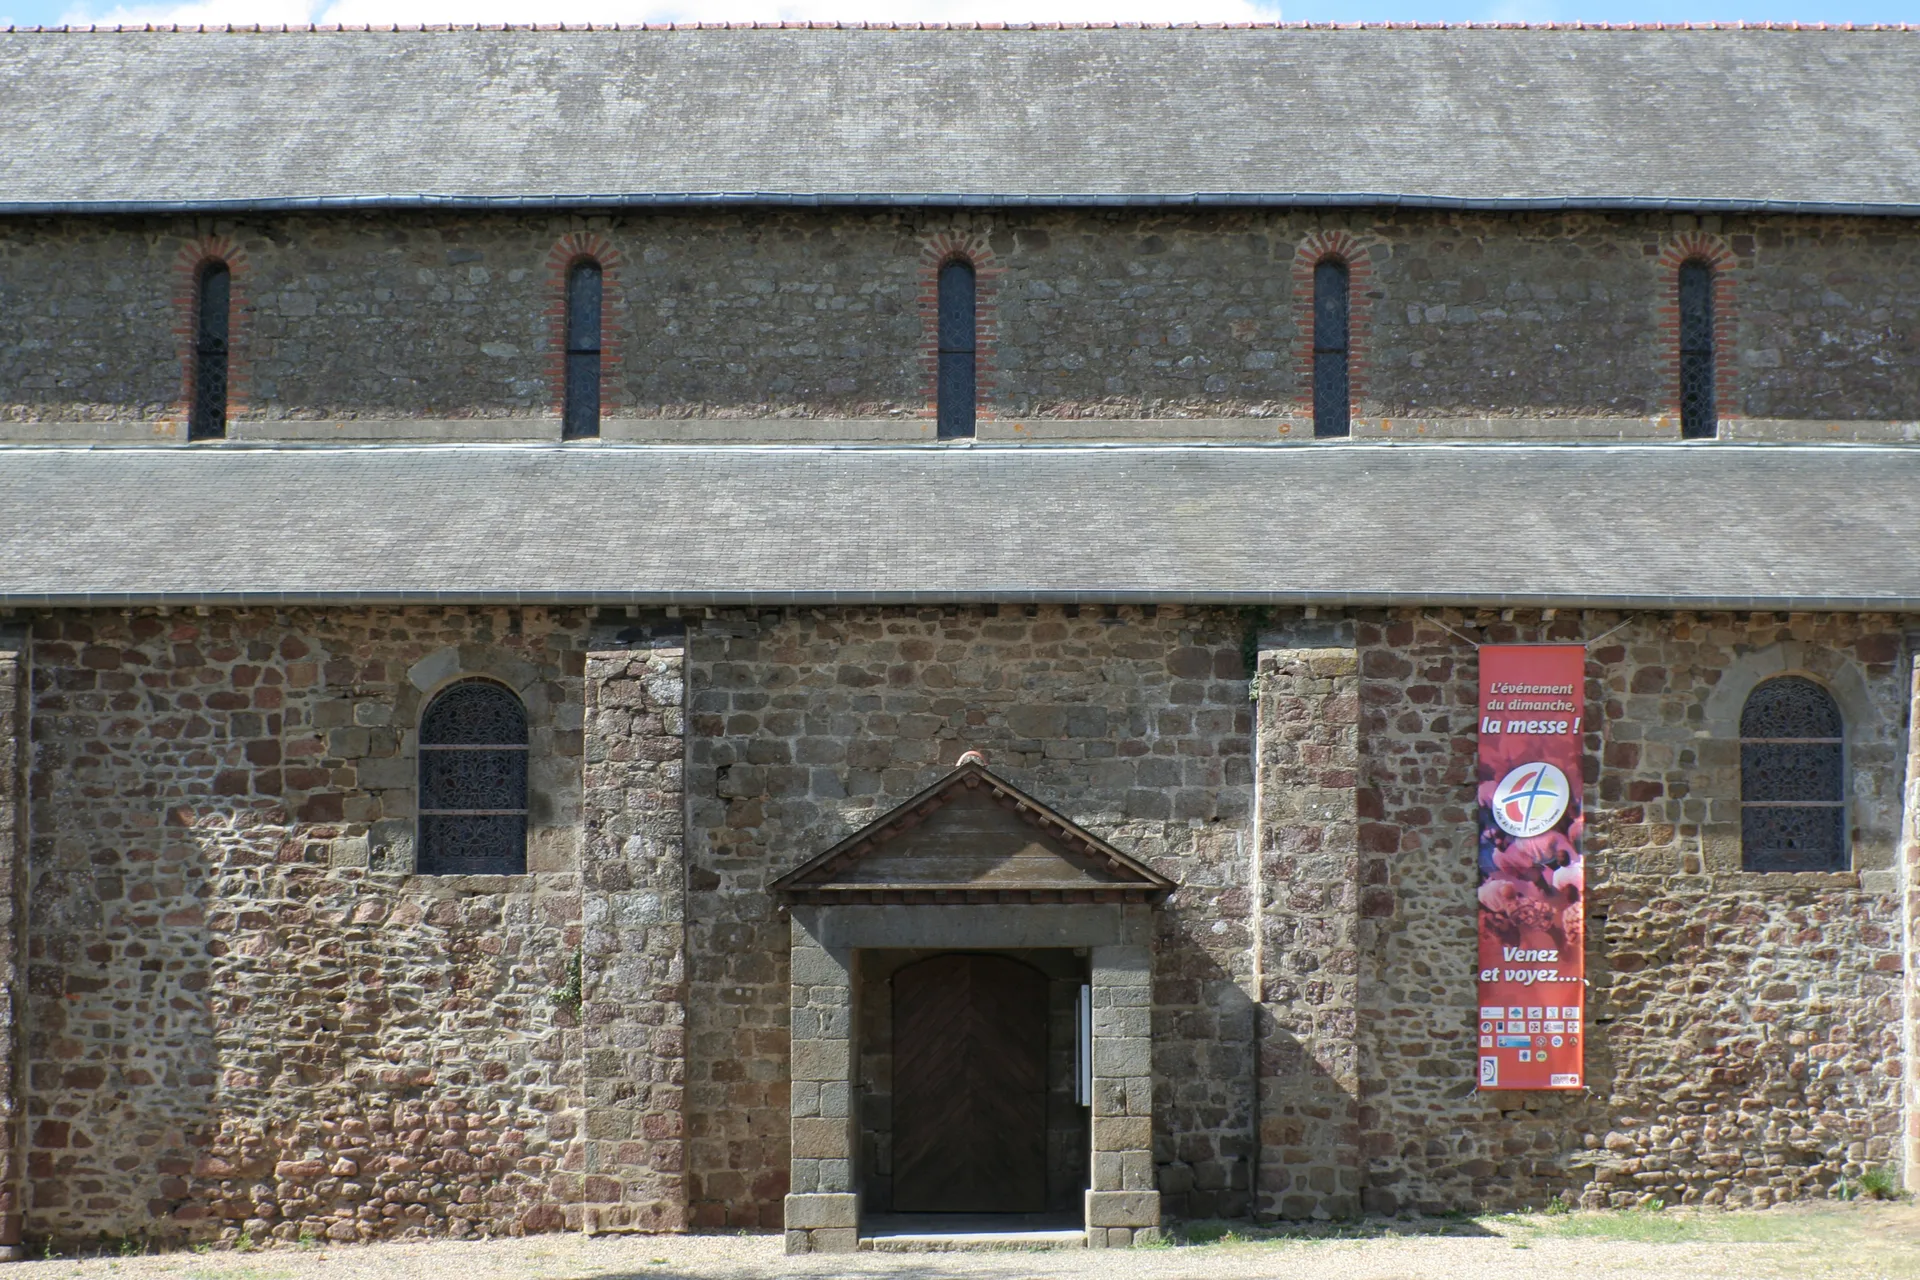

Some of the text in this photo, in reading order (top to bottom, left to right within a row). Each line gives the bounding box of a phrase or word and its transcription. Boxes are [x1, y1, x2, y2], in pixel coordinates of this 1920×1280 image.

[1487, 700, 1575, 712] du dimanche,
[1481, 717, 1581, 734] la messe !
[1503, 947, 1558, 962] Venez
[1480, 968, 1500, 982] et
